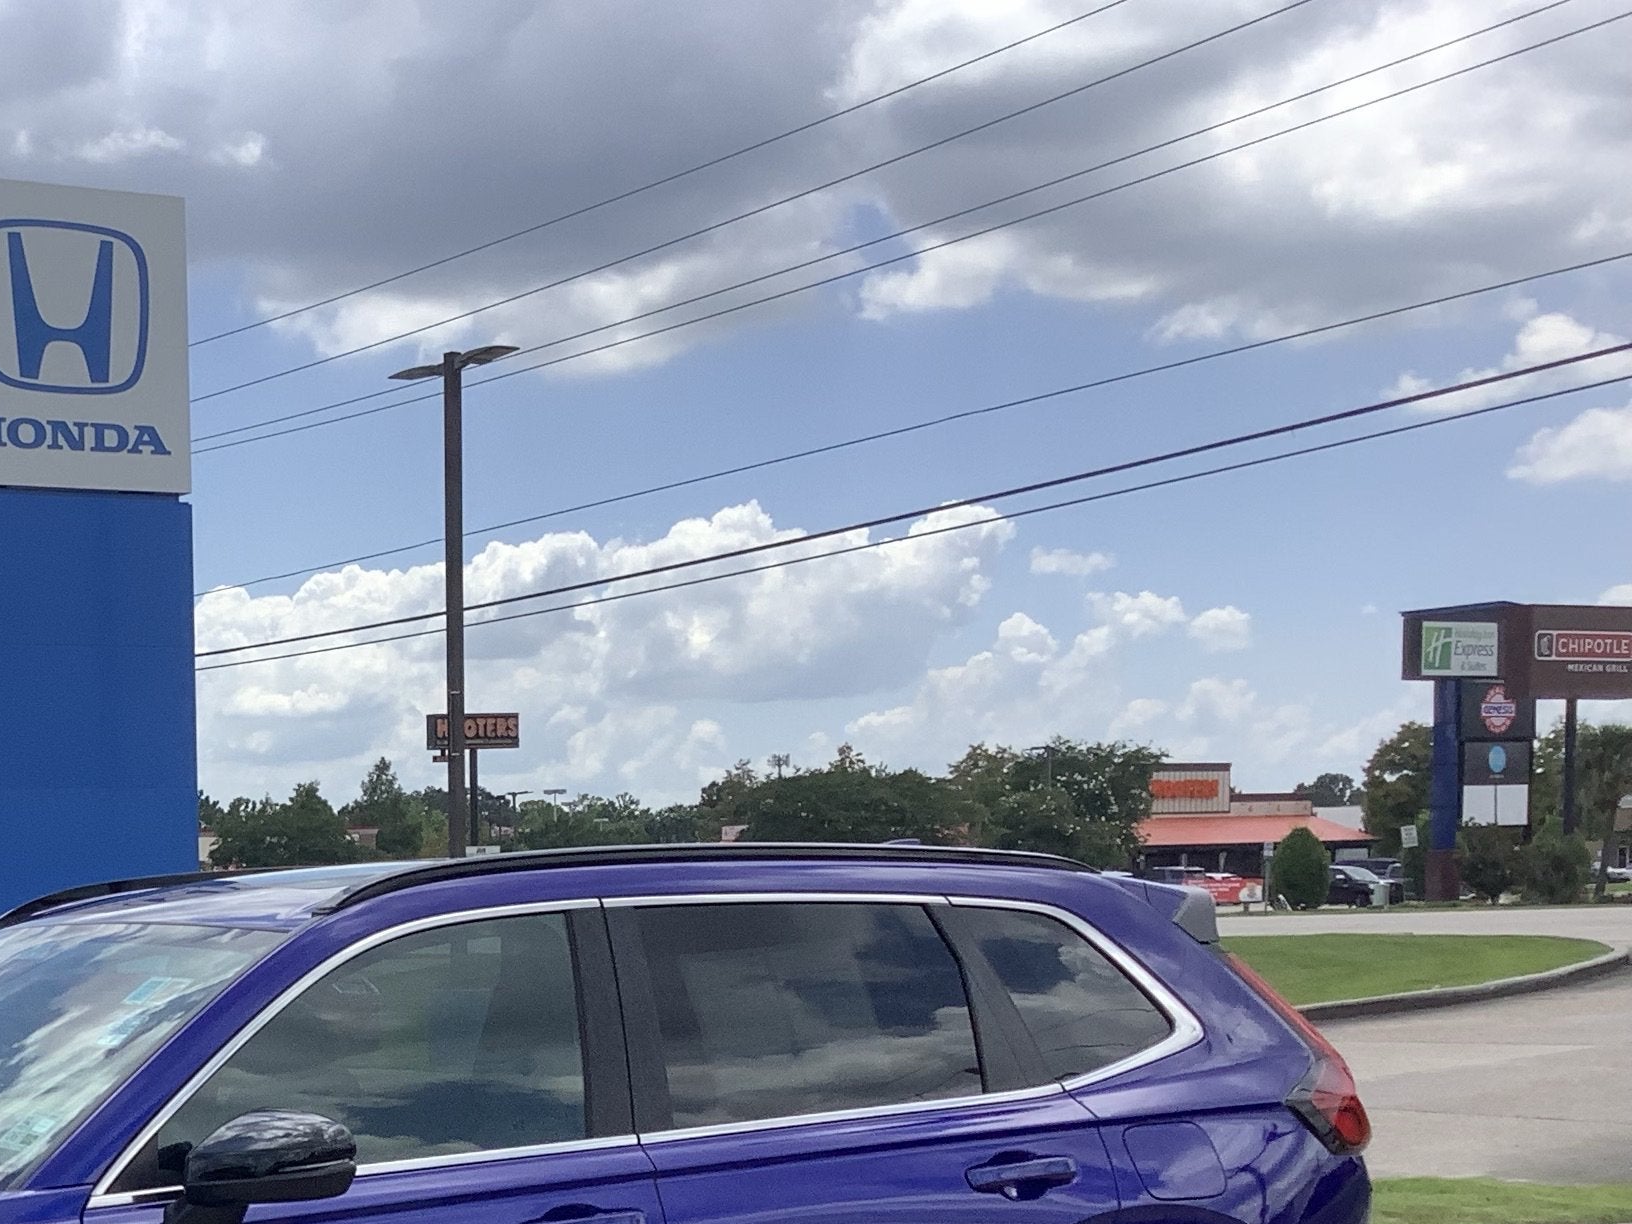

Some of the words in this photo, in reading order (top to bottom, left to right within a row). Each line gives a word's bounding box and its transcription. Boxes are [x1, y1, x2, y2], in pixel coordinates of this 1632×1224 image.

[1454, 640, 1495, 660] Express
[1558, 638, 1630, 654] CHIPOTLE
[1568, 663, 1604, 672] MEXICAN
[1605, 664, 1628, 673] GRILL
[436, 717, 518, 738] HOTERS
